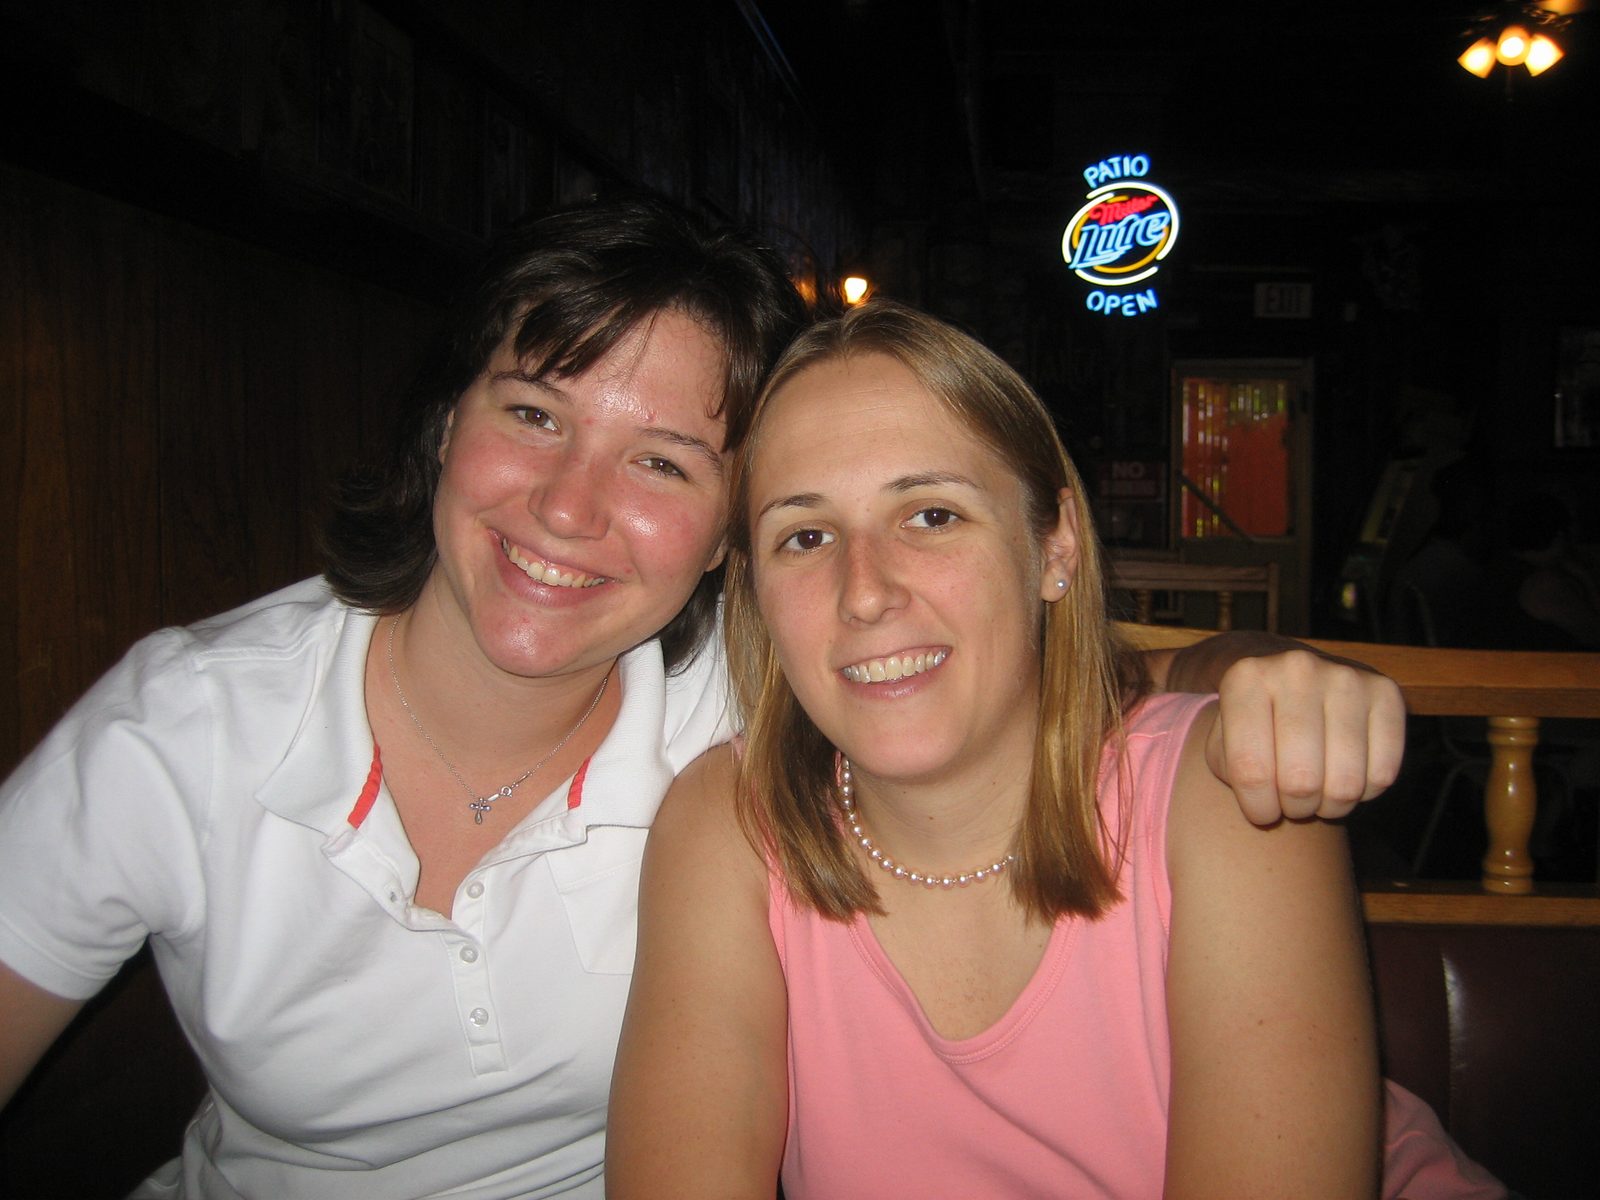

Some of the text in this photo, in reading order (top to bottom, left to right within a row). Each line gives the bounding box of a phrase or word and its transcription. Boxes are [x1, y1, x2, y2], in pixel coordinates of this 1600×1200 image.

[1083, 155, 1149, 188] PATIO
[1086, 290, 1158, 317] OPEN
[1111, 461, 1145, 480] NO
